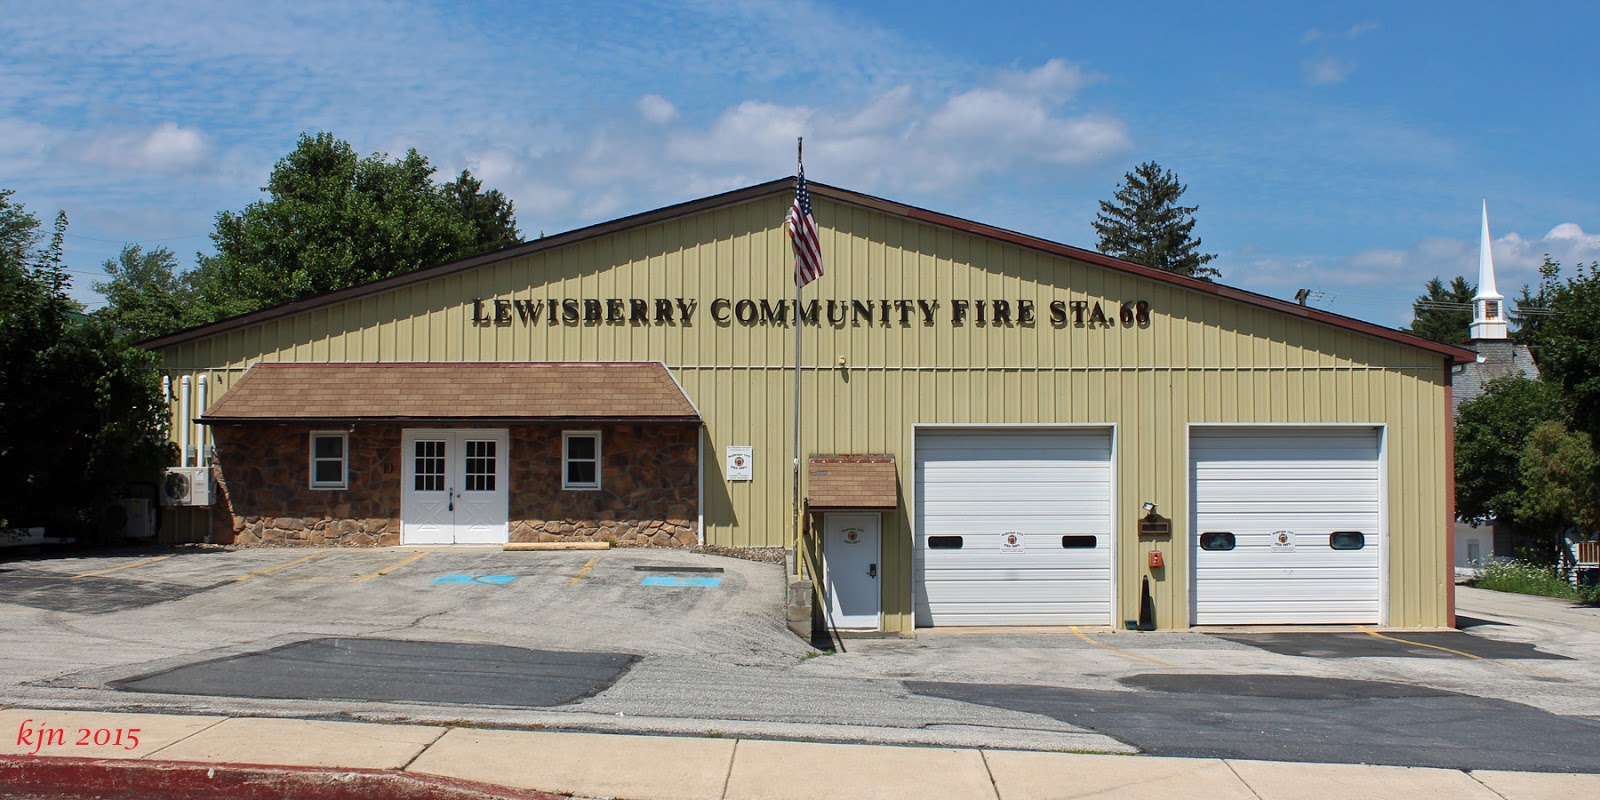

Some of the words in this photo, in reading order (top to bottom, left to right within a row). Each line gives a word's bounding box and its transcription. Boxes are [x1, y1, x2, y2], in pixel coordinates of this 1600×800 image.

[471, 298, 697, 322] LEWISBERRY
[710, 298, 938, 323] COMMUNITY
[950, 299, 1035, 323] FIRE
